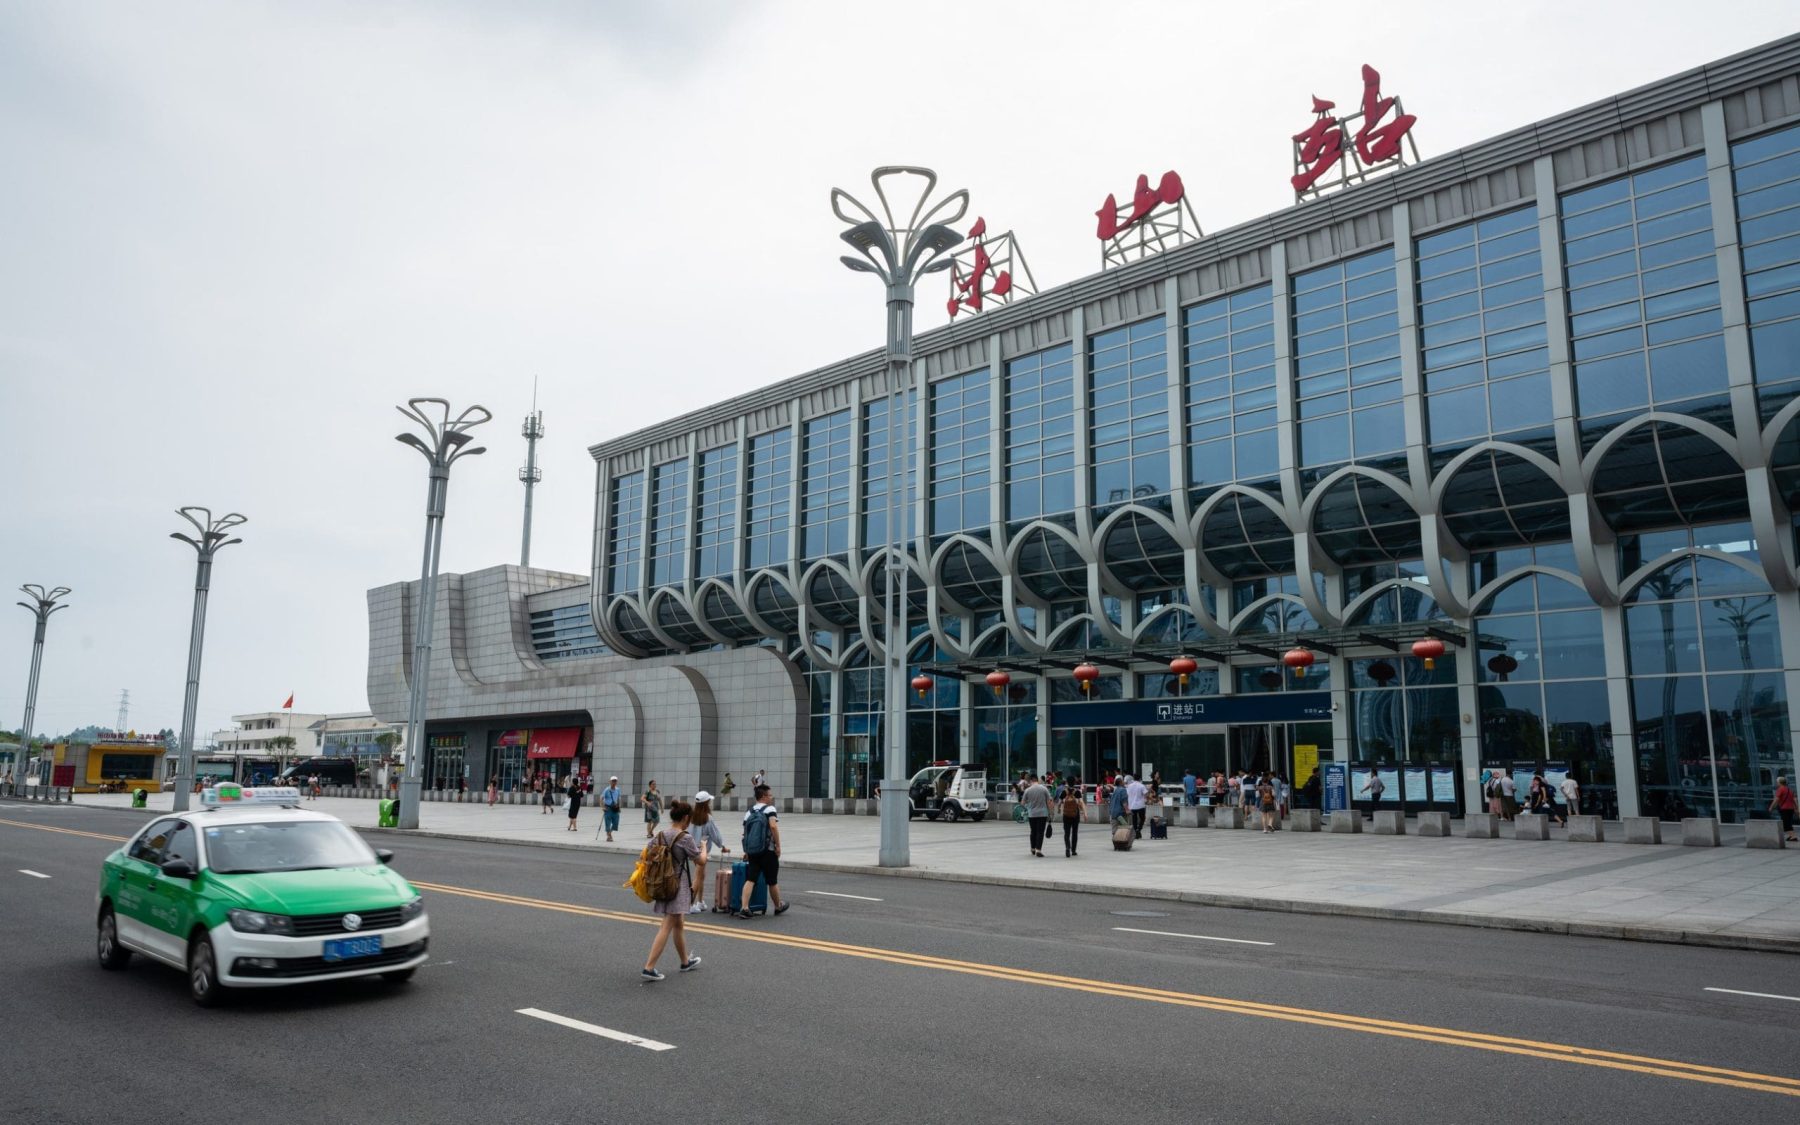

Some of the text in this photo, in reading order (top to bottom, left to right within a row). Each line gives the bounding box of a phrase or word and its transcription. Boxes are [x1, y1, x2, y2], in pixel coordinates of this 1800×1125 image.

[947, 63, 1417, 317] 乐山站
[1173, 703, 1204, 715] 进站口
[538, 746, 550, 754] KFC
